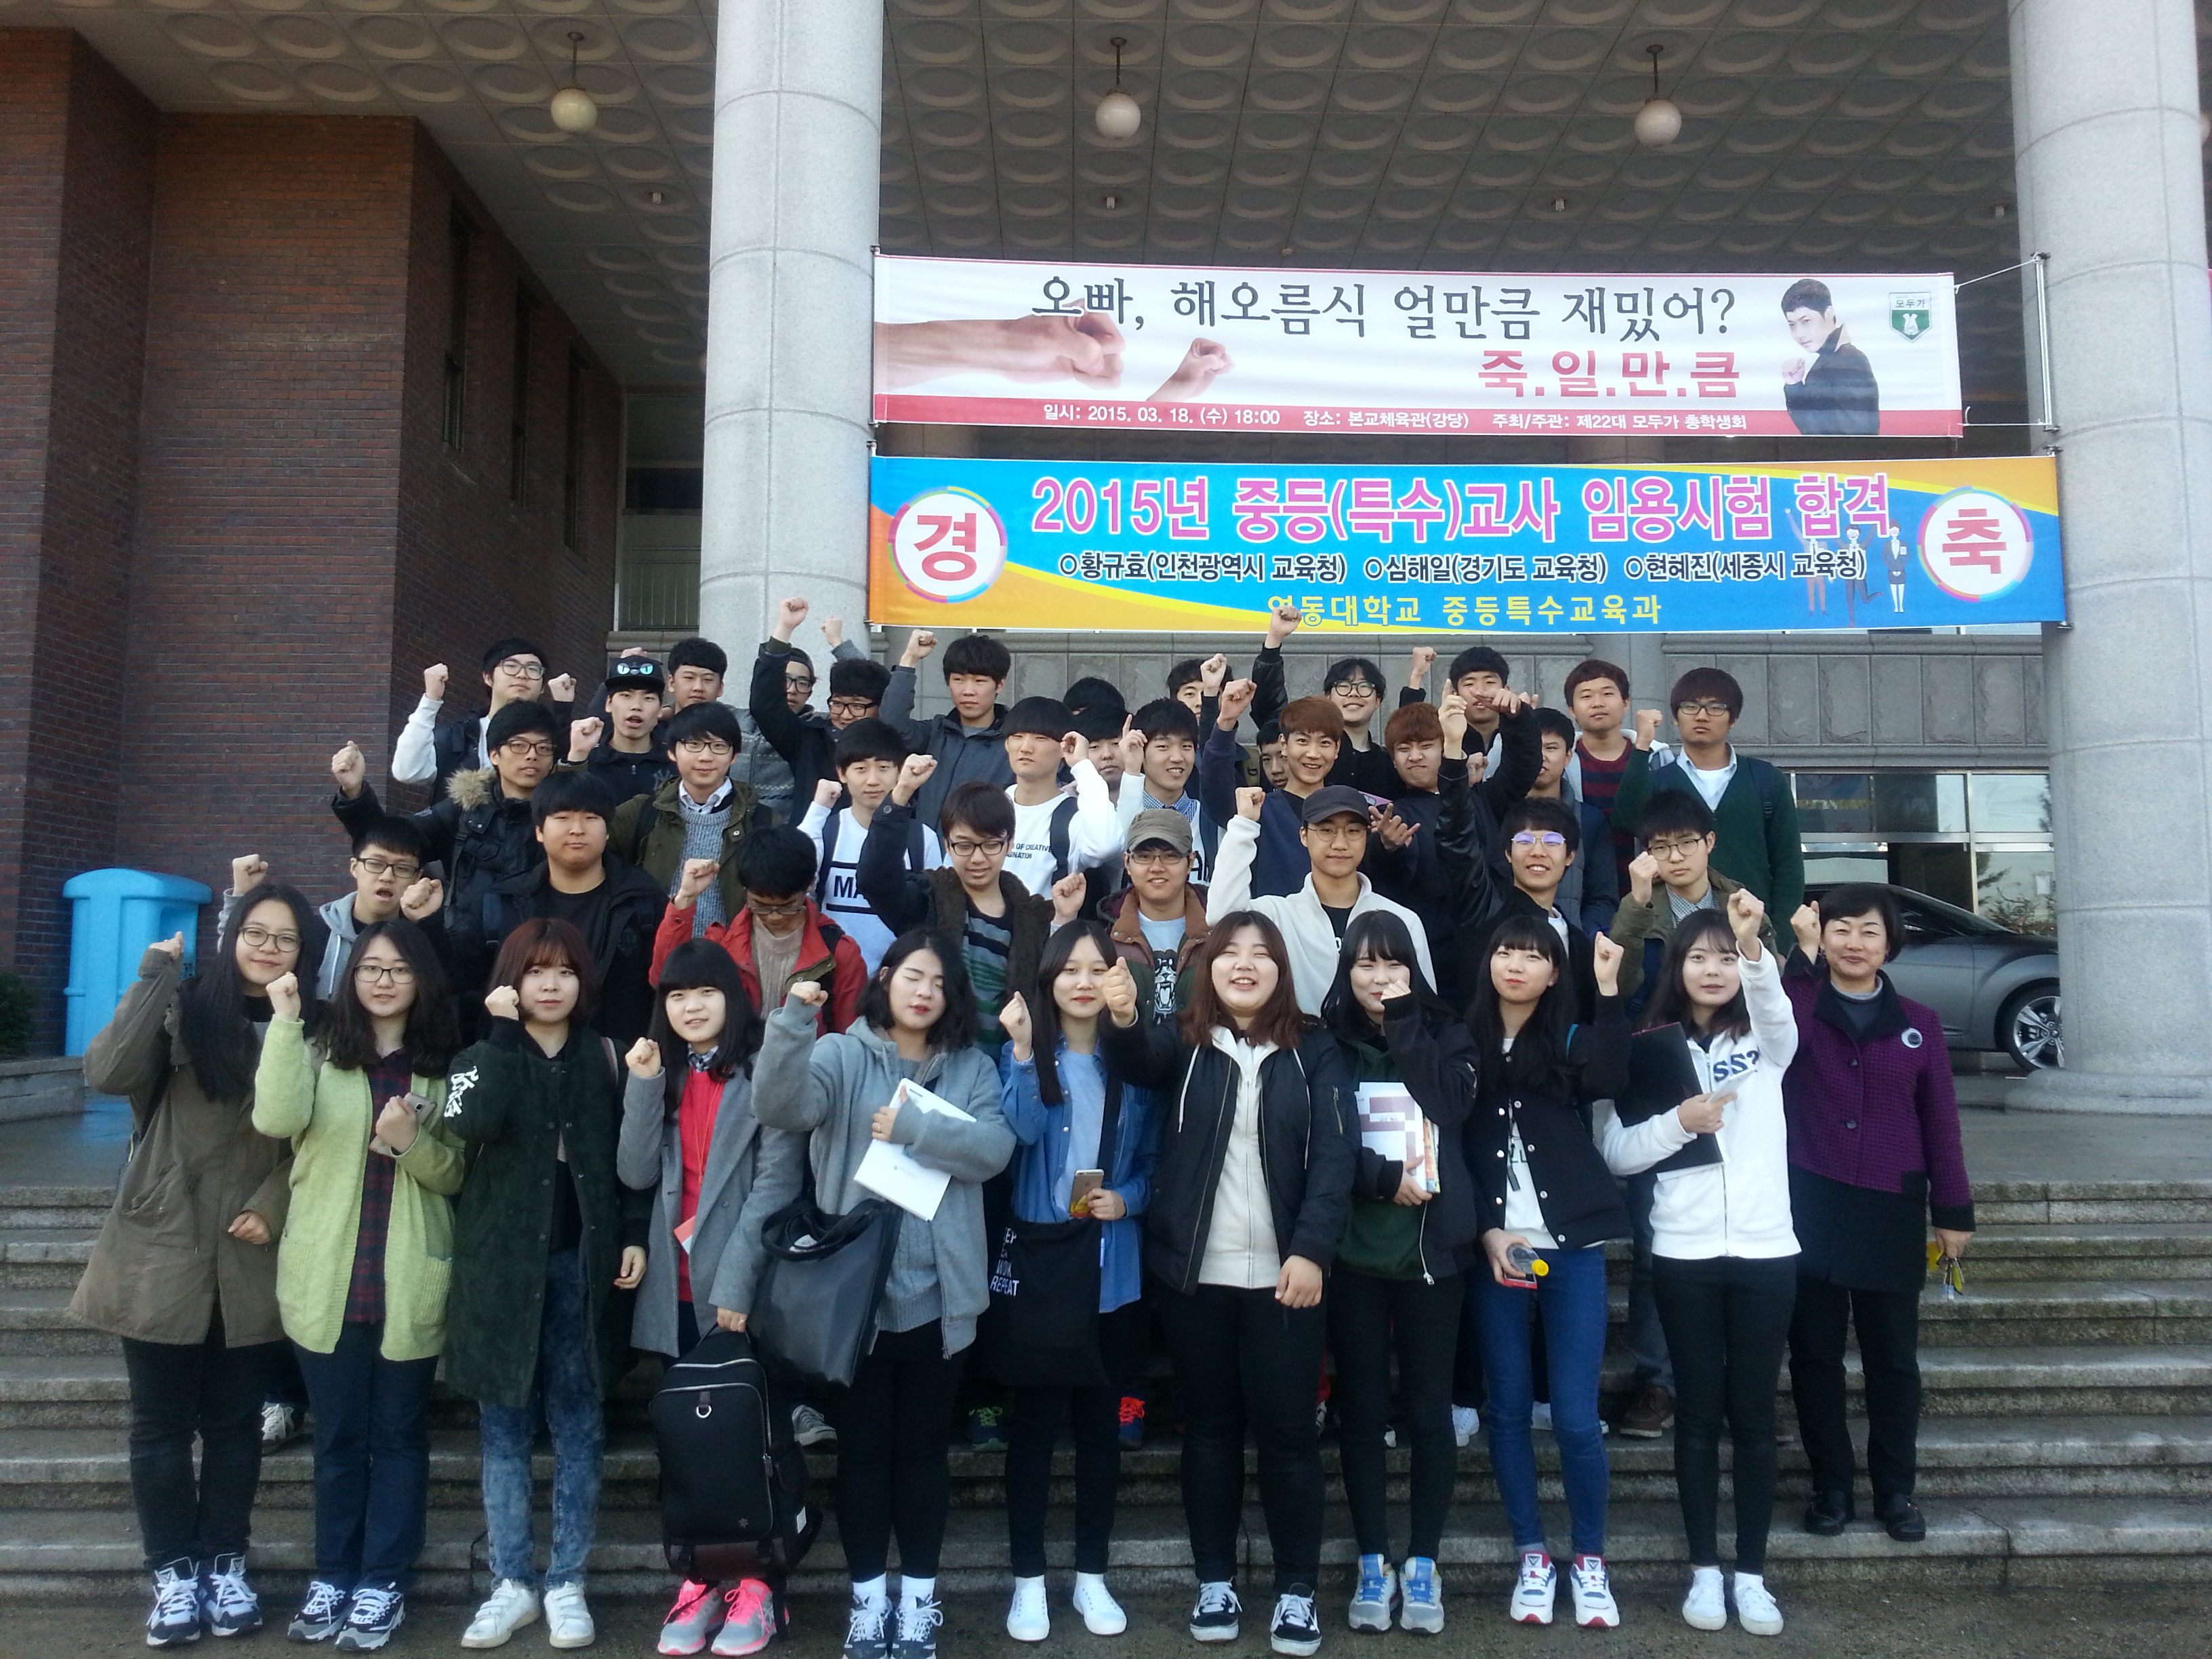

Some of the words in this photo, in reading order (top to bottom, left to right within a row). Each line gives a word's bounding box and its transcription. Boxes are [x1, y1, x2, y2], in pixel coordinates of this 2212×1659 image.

[1031, 275, 1145, 331] 오빠,
[1170, 281, 1366, 338] 해오름식
[1394, 285, 1540, 340] 얼만큼
[1562, 286, 1736, 343] 재밌어?
[1896, 298, 1925, 308] 모두가
[1043, 404, 1081, 421] 일시:
[1088, 406, 1132, 422] 2015.
[1137, 407, 1162, 423] 03.
[1170, 408, 1193, 424] 18.
[1200, 407, 1227, 426] (수)
[1235, 409, 1280, 425] 18:00
[1303, 410, 1341, 426] 장소:
[1348, 411, 1469, 429] 본교체육관(강당)
[1492, 413, 1570, 429] 주최/주관:
[1576, 414, 1626, 430] 제22대
[1632, 414, 1679, 430] 모두가
[1684, 414, 1747, 430] 총학생회
[1032, 476, 1208, 539] 2015년
[1233, 477, 1559, 542] 중등(특수)교사
[1582, 474, 1771, 541] 임용시험
[1796, 472, 1889, 538] 합격
[914, 512, 977, 581] 경
[1942, 508, 2007, 574] 축
[1271, 554, 1347, 583] 교육청)
[1532, 552, 1607, 583] 교육청)
[1791, 550, 1867, 581] 교육청)
[1442, 594, 1662, 626] 중등특수교육과
[989, 1275, 1020, 1296] REPEAT
